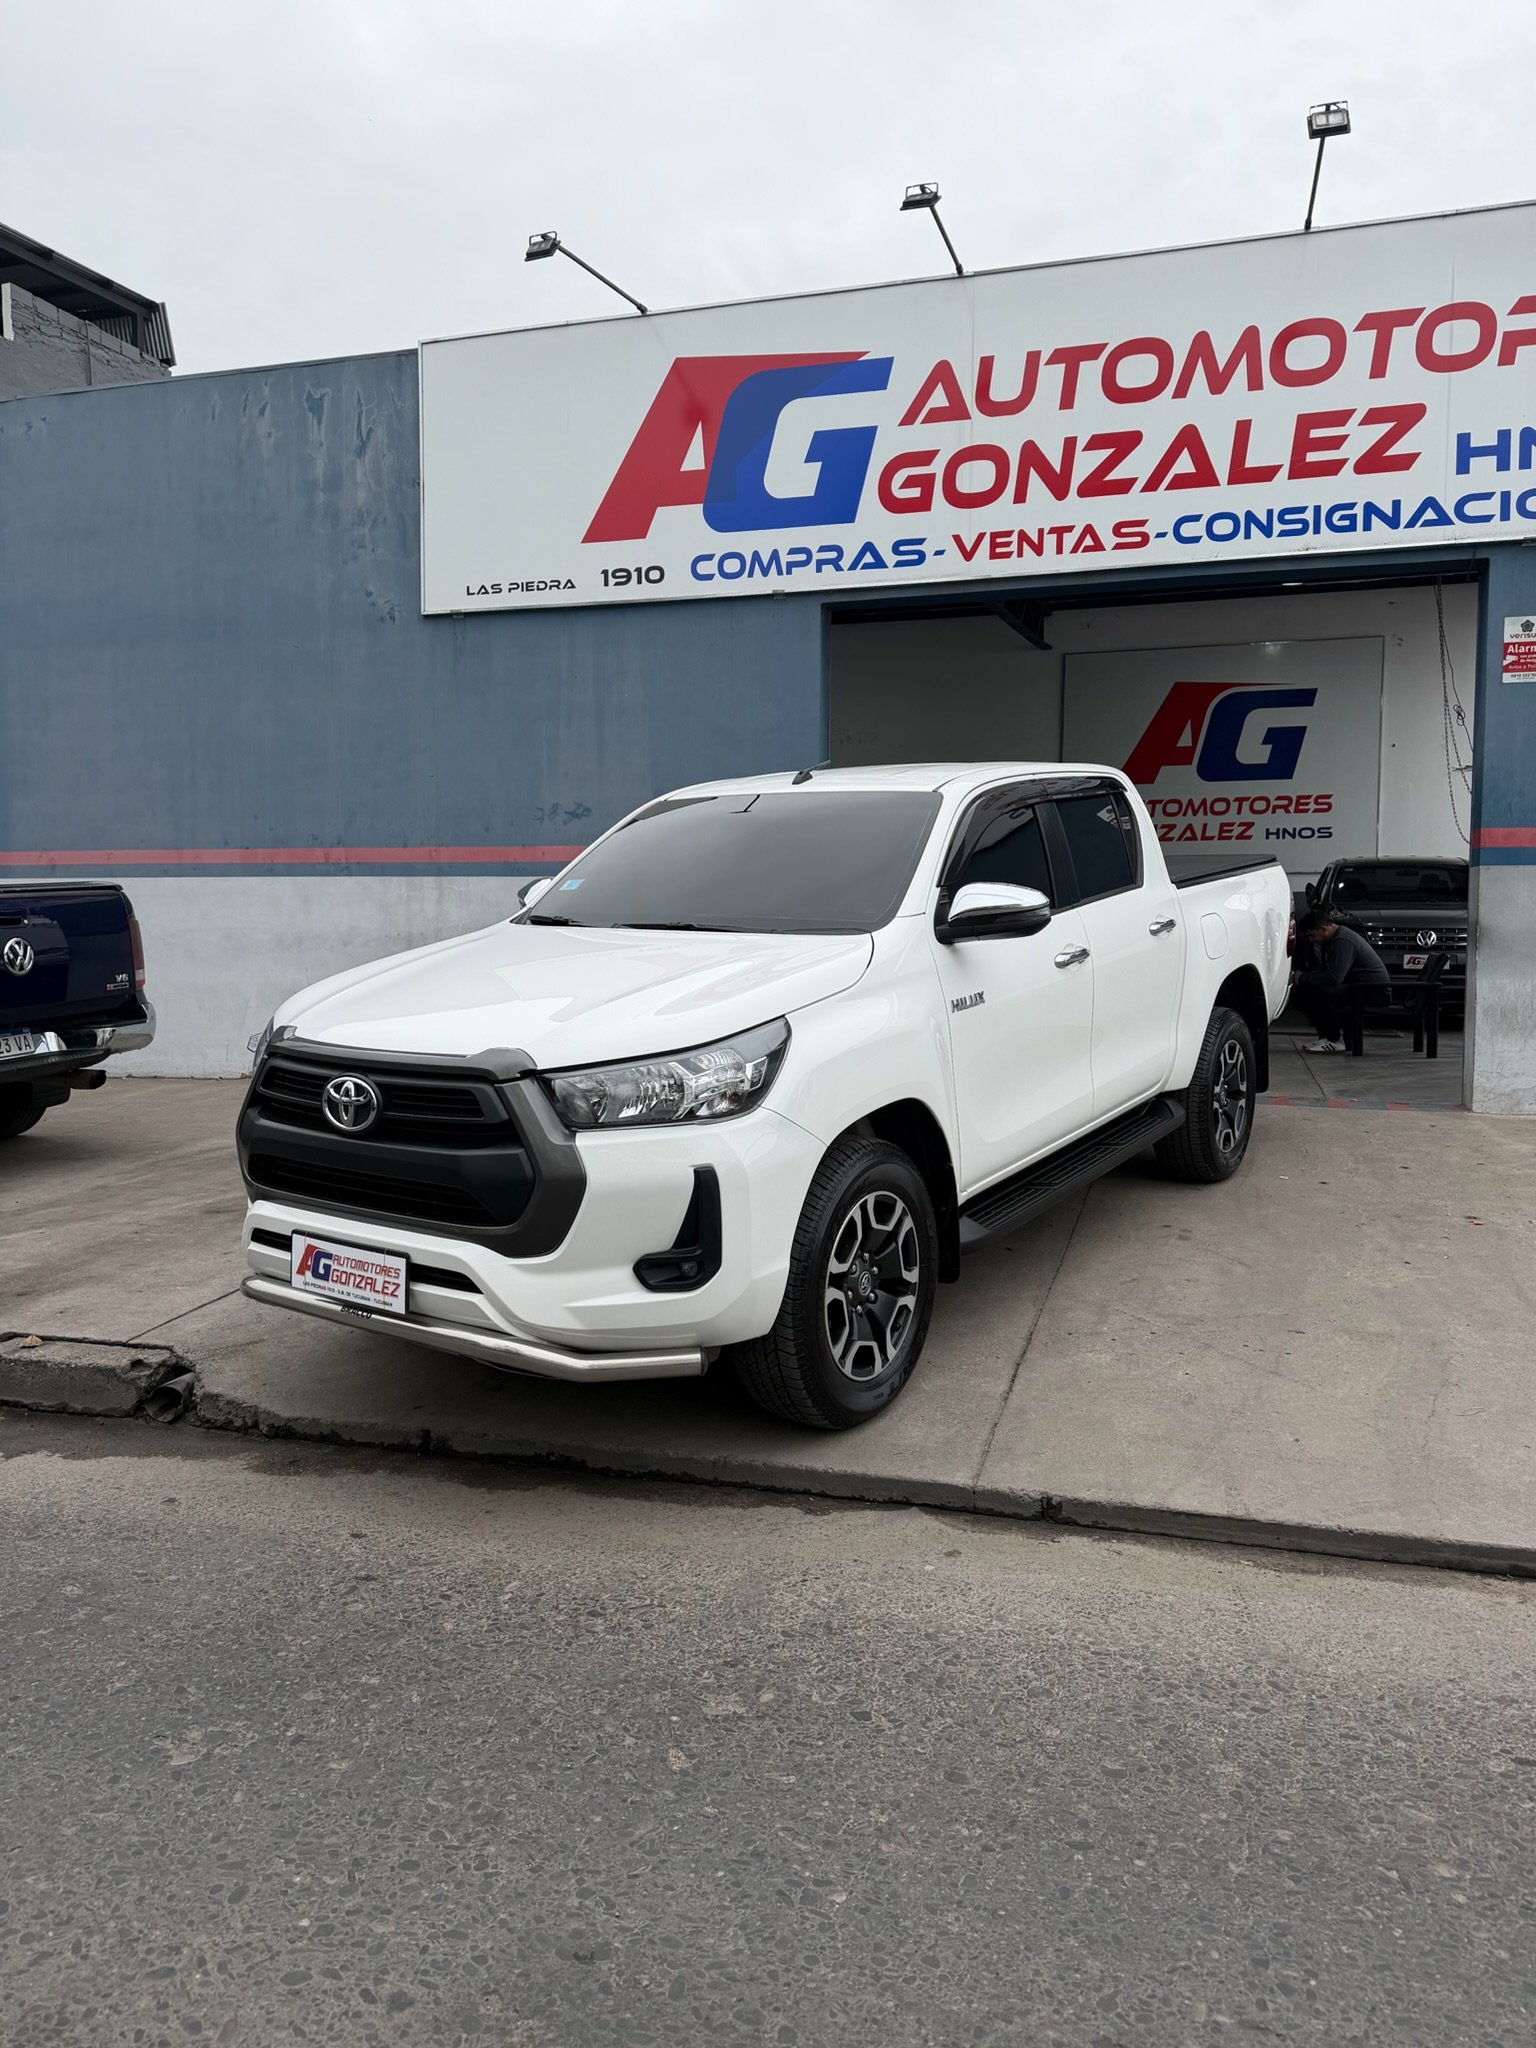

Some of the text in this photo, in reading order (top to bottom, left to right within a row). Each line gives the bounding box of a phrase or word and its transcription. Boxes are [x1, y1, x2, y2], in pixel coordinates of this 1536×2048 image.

[580, 350, 895, 545] AG
[877, 402, 1428, 515] GONZALEZ
[466, 565, 666, 596] LAS PIEDRA 1910
[1121, 681, 1319, 783] AG
[1143, 793, 1334, 818] TOMOTORES
[1154, 822, 1333, 842] ZALEZ HNOS
[115, 973, 129, 983] V6
[951, 990, 985, 1013] HILUX
[14, 1034, 32, 1051] VA
[296, 1243, 334, 1282] AG
[332, 1254, 401, 1279] AUTOMOTORES
[330, 1268, 401, 1298] GONZALEZ
